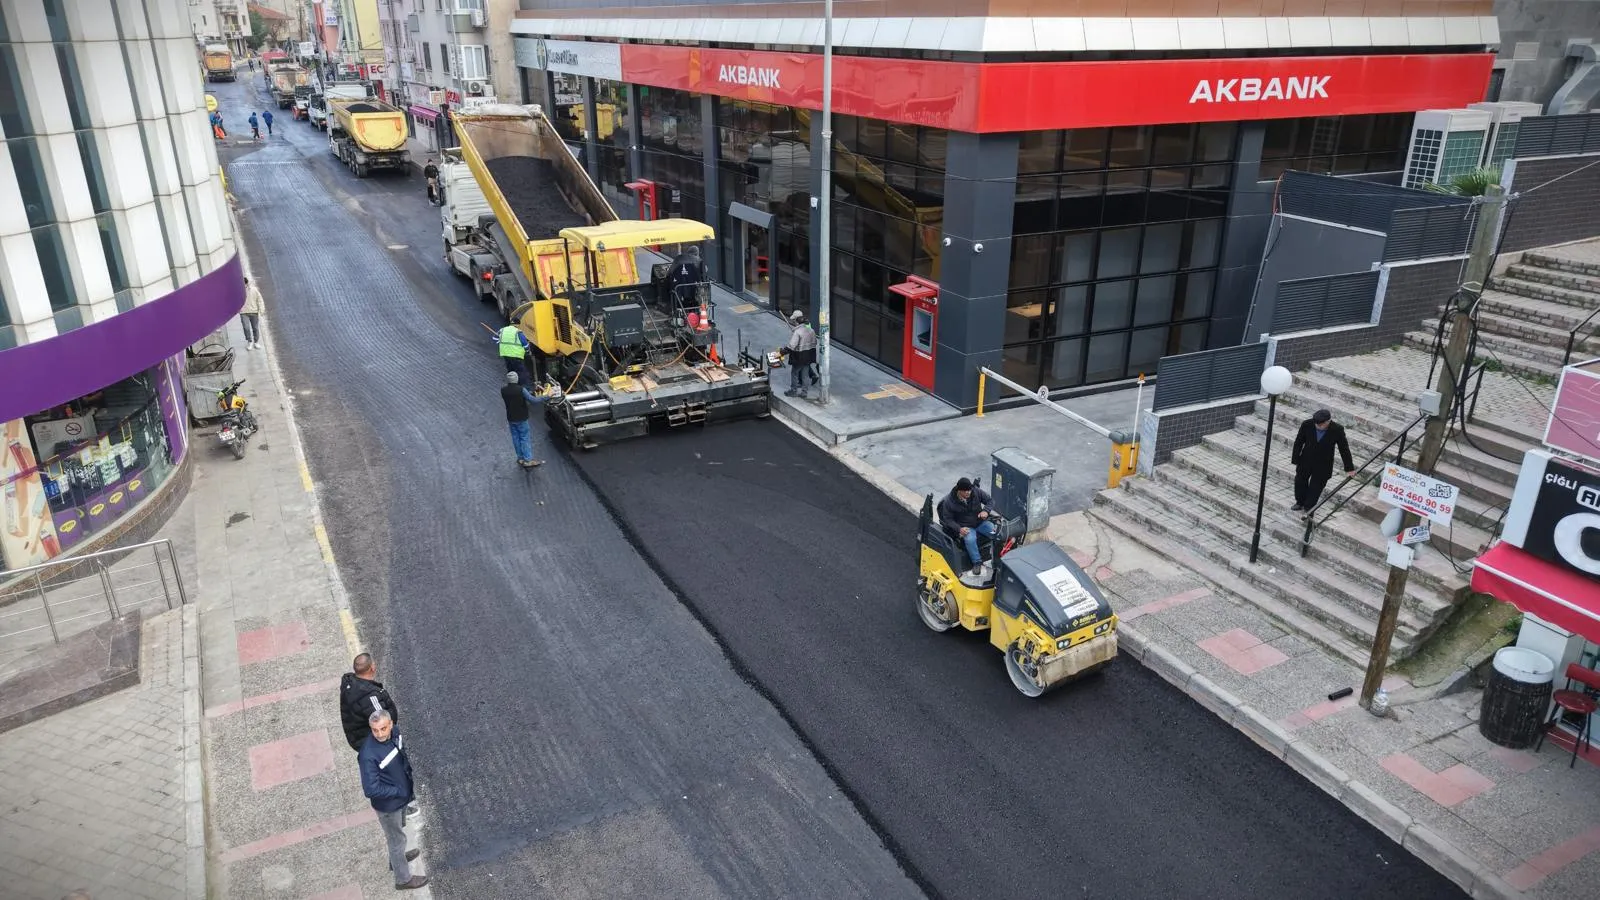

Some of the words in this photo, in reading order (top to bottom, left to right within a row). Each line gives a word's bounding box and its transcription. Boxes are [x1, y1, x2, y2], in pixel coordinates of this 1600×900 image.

[718, 64, 781, 89] AKBANK
[1189, 75, 1332, 104] AKBANK
[1545, 473, 1578, 490] ÇİĞLİ
[1382, 482, 1404, 497] 0542
[1406, 491, 1423, 504] 460
[1425, 498, 1437, 509] 90
[1440, 504, 1451, 514] 59
